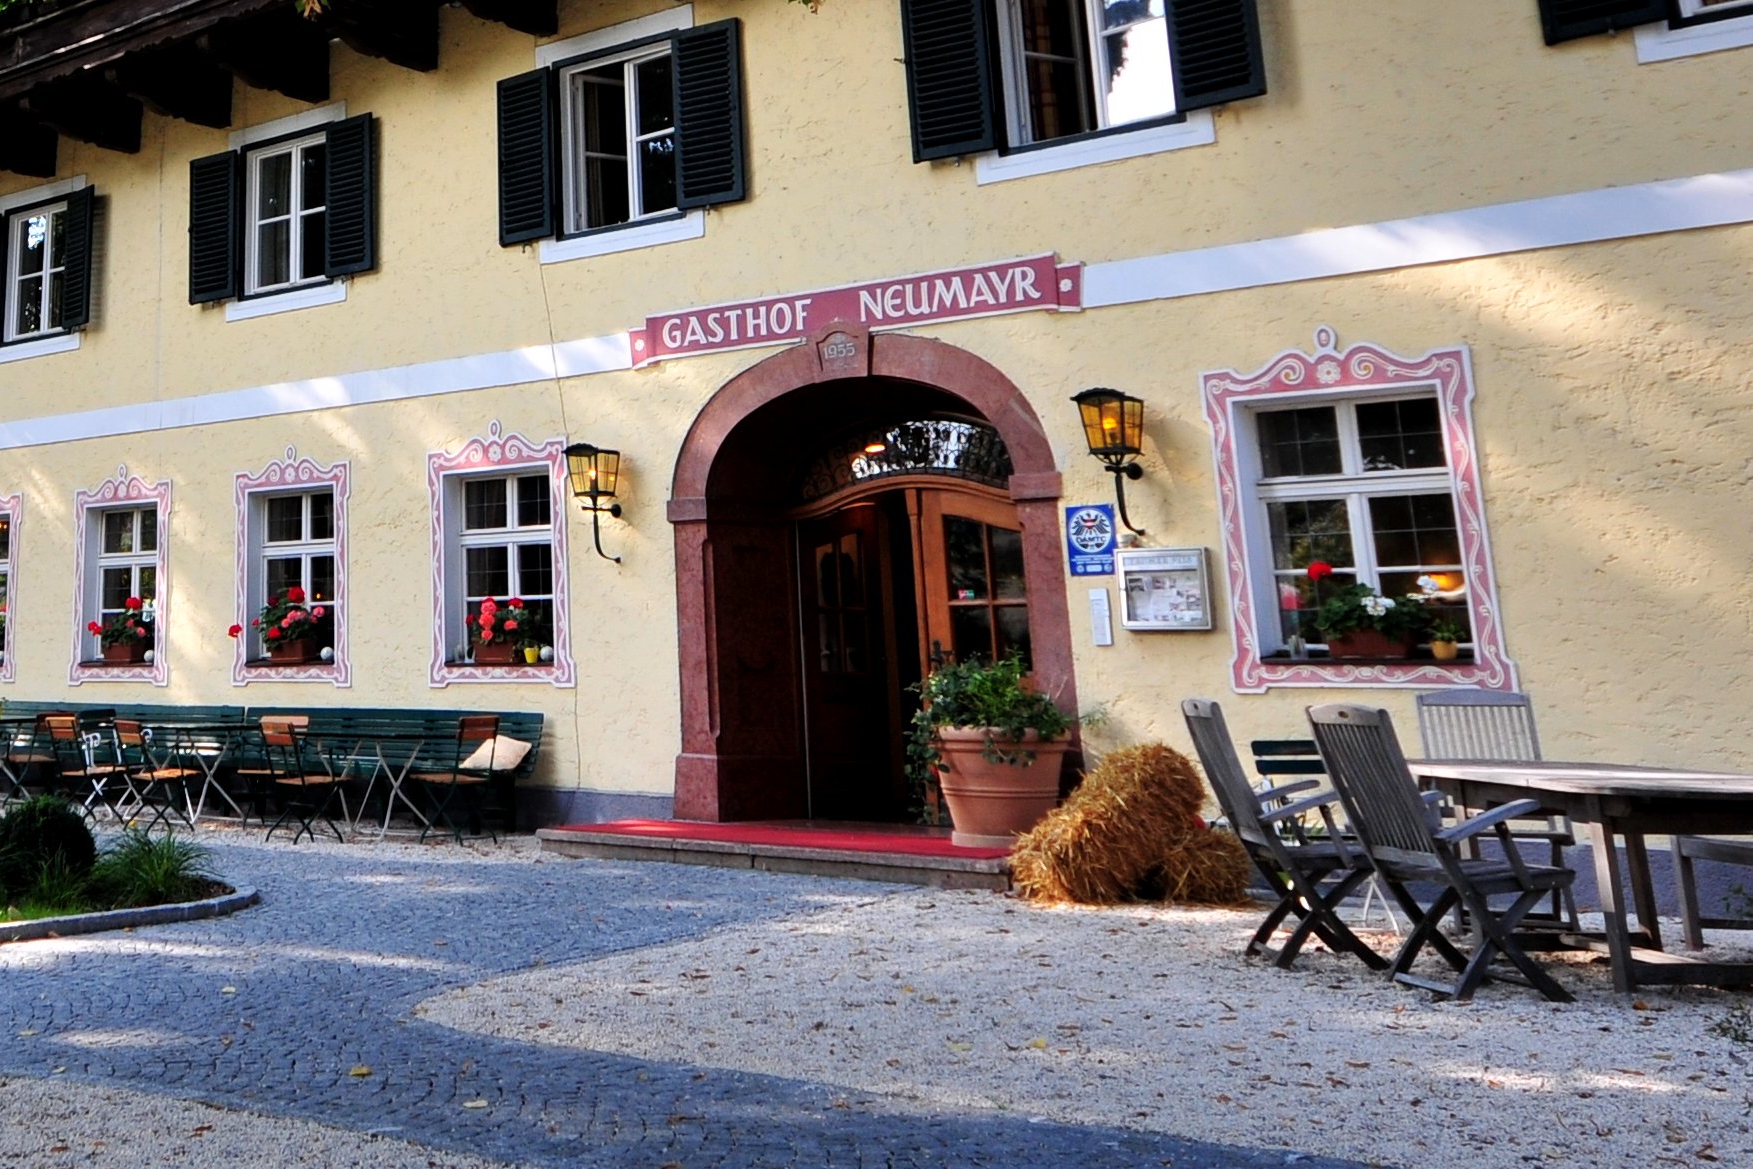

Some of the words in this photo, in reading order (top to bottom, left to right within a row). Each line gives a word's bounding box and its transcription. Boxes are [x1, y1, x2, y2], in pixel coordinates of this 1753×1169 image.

[662, 298, 812, 349] GASTHOF
[859, 266, 1042, 322] NEUMAYR
[823, 342, 855, 359] 1955
